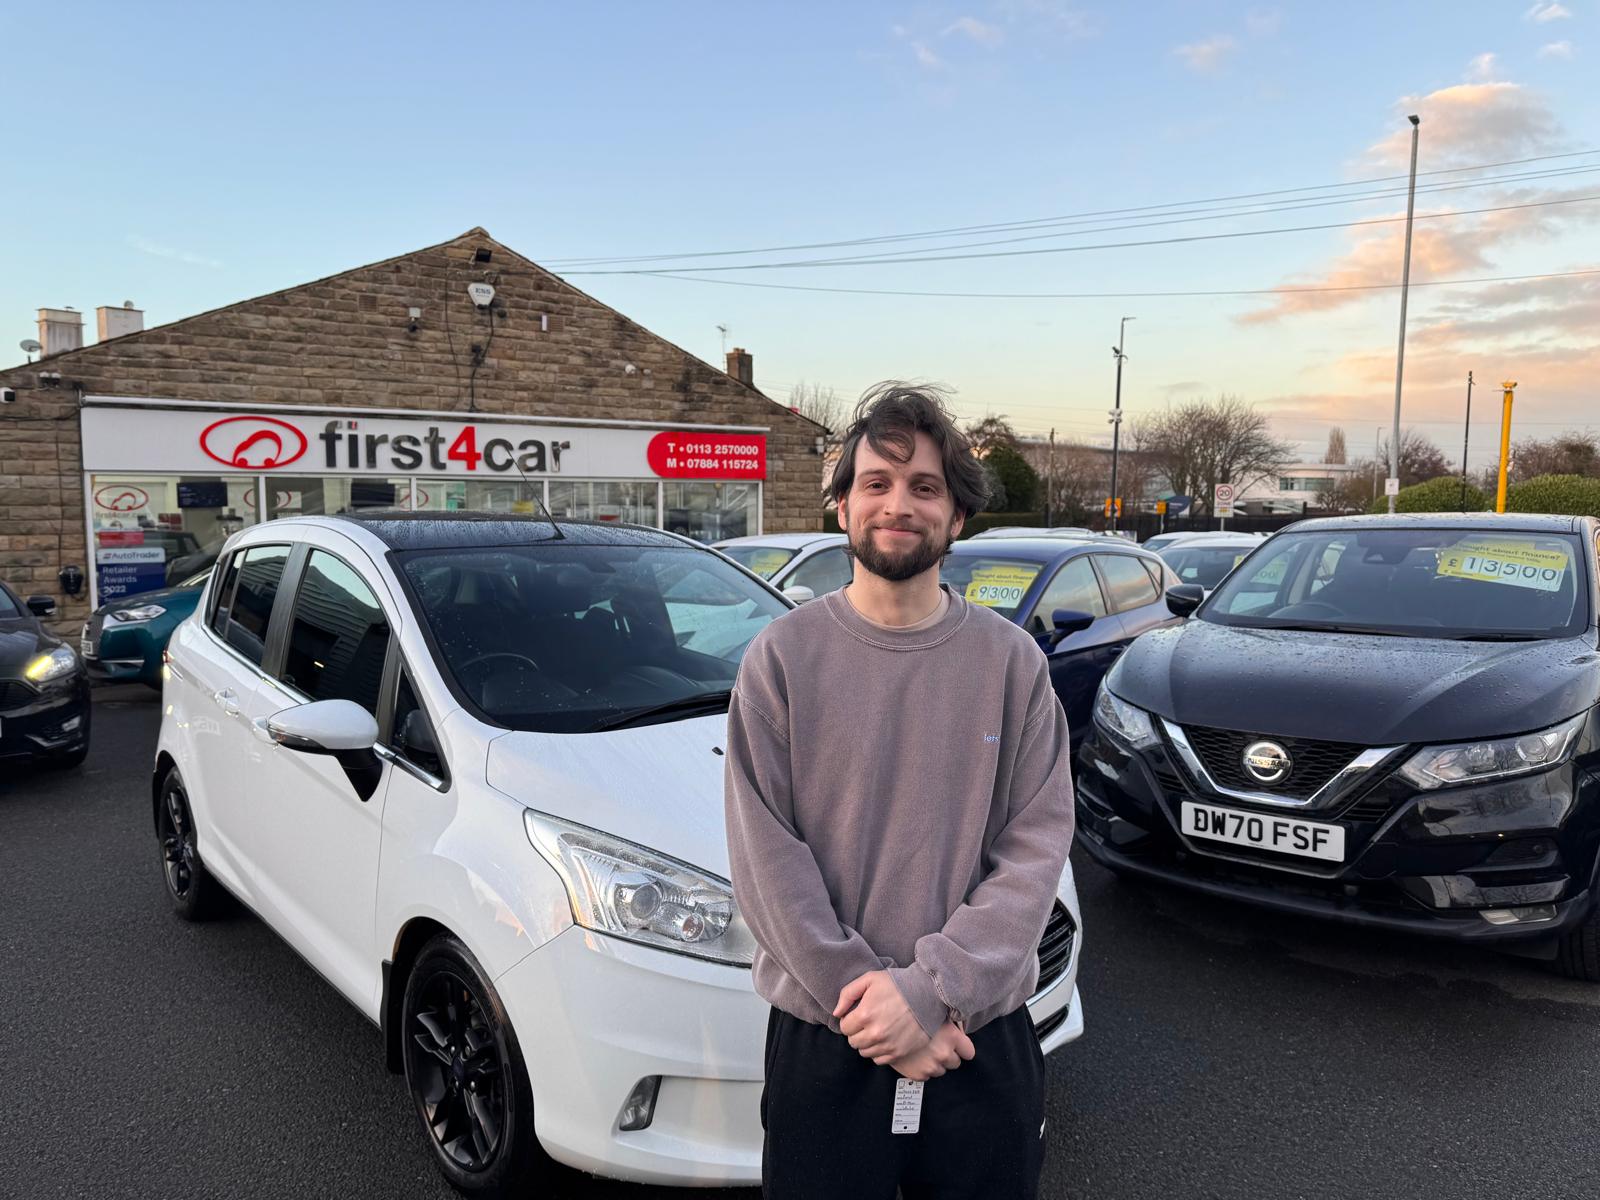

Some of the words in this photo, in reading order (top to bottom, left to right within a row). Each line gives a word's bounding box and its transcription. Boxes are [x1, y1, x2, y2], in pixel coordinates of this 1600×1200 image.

[319, 420, 571, 472] first4car
[667, 443, 676, 453] T
[686, 443, 712, 454] 0113
[714, 445, 759, 455] 2570000
[666, 458, 677, 468] M
[686, 459, 719, 469] 07884
[721, 460, 759, 470] 115724
[1219, 489, 1230, 497] 20
[111, 551, 160, 560] AutoTrader
[103, 566, 137, 574] Retailer
[103, 576, 137, 584] Awards
[103, 585, 127, 594] 2022
[1247, 757, 1289, 769] NISSAN
[1193, 807, 1264, 843] DW70
[1272, 821, 1331, 852] FSF
